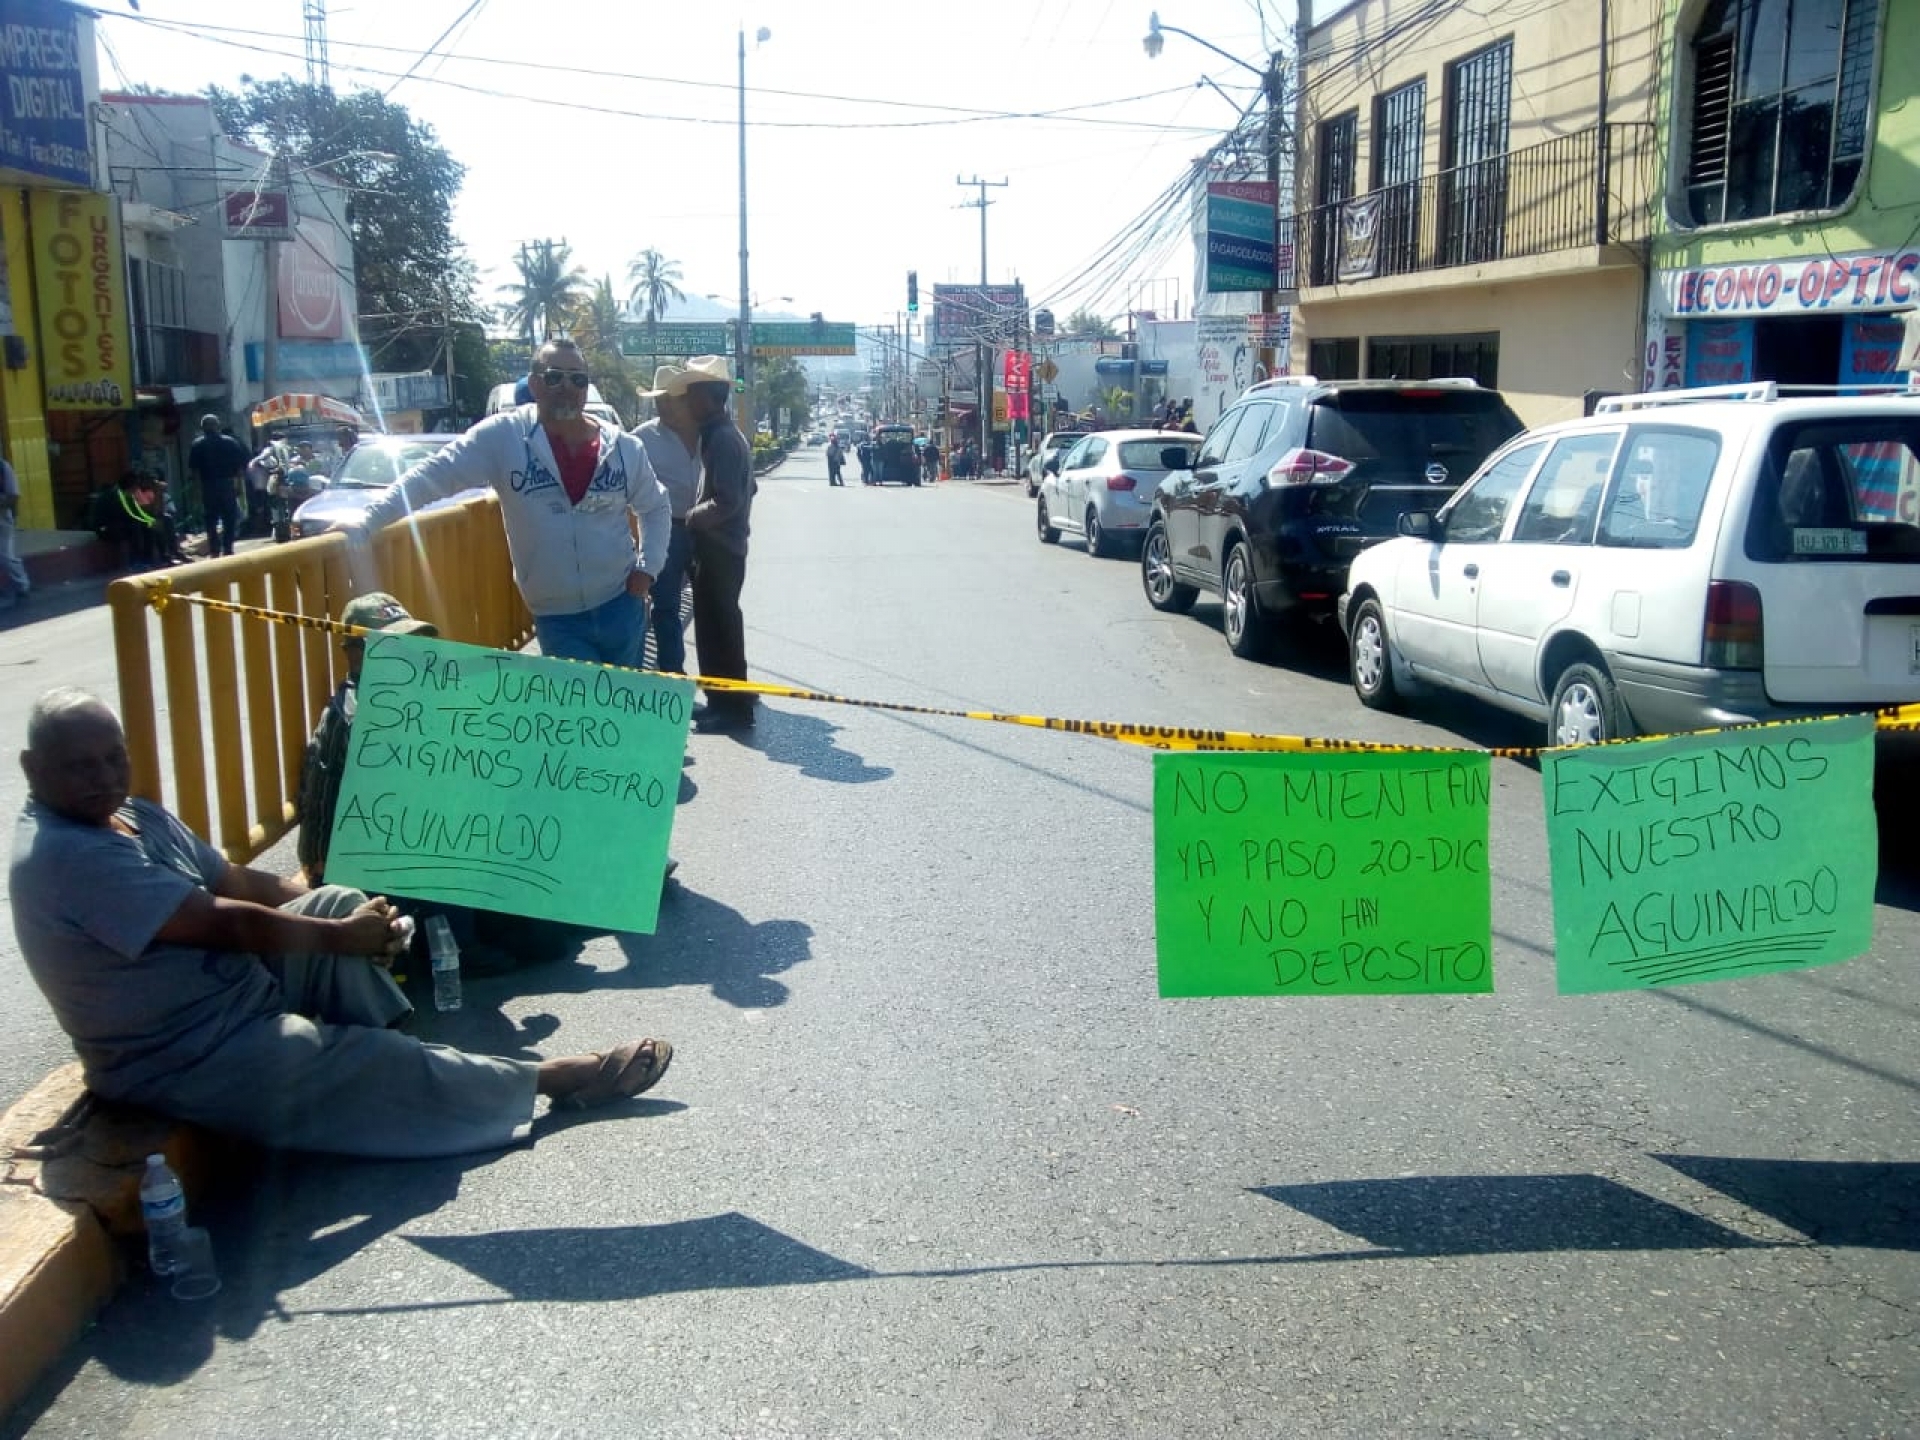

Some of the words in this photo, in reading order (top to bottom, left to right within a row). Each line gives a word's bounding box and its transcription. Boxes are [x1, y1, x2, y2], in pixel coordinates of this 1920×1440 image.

[9, 74, 83, 120] DIGITAL
[48, 193, 88, 378] FOTOS
[1209, 241, 1273, 264] ENGARGOLADOS
[477, 655, 587, 706] JUANA
[594, 671, 684, 725] OCAMPO
[437, 707, 621, 748] TESORERO
[357, 727, 523, 788] EXIGIMOS
[534, 753, 664, 808] NUESTRO
[1174, 768, 1249, 817] NO
[1283, 763, 1490, 822] MIENTAN
[1553, 737, 1828, 817] EXIGIMOS
[337, 792, 562, 862] AGUINALDO
[1176, 839, 1217, 881] YA
[1240, 838, 1337, 881] PASO
[1360, 836, 1483, 877] 20-DIC
[1576, 801, 1781, 888] NUESTRO
[1197, 896, 1215, 943] Y
[1240, 898, 1308, 945] NO
[1341, 897, 1380, 937] HAY
[1588, 865, 1838, 958] AGUINALDO
